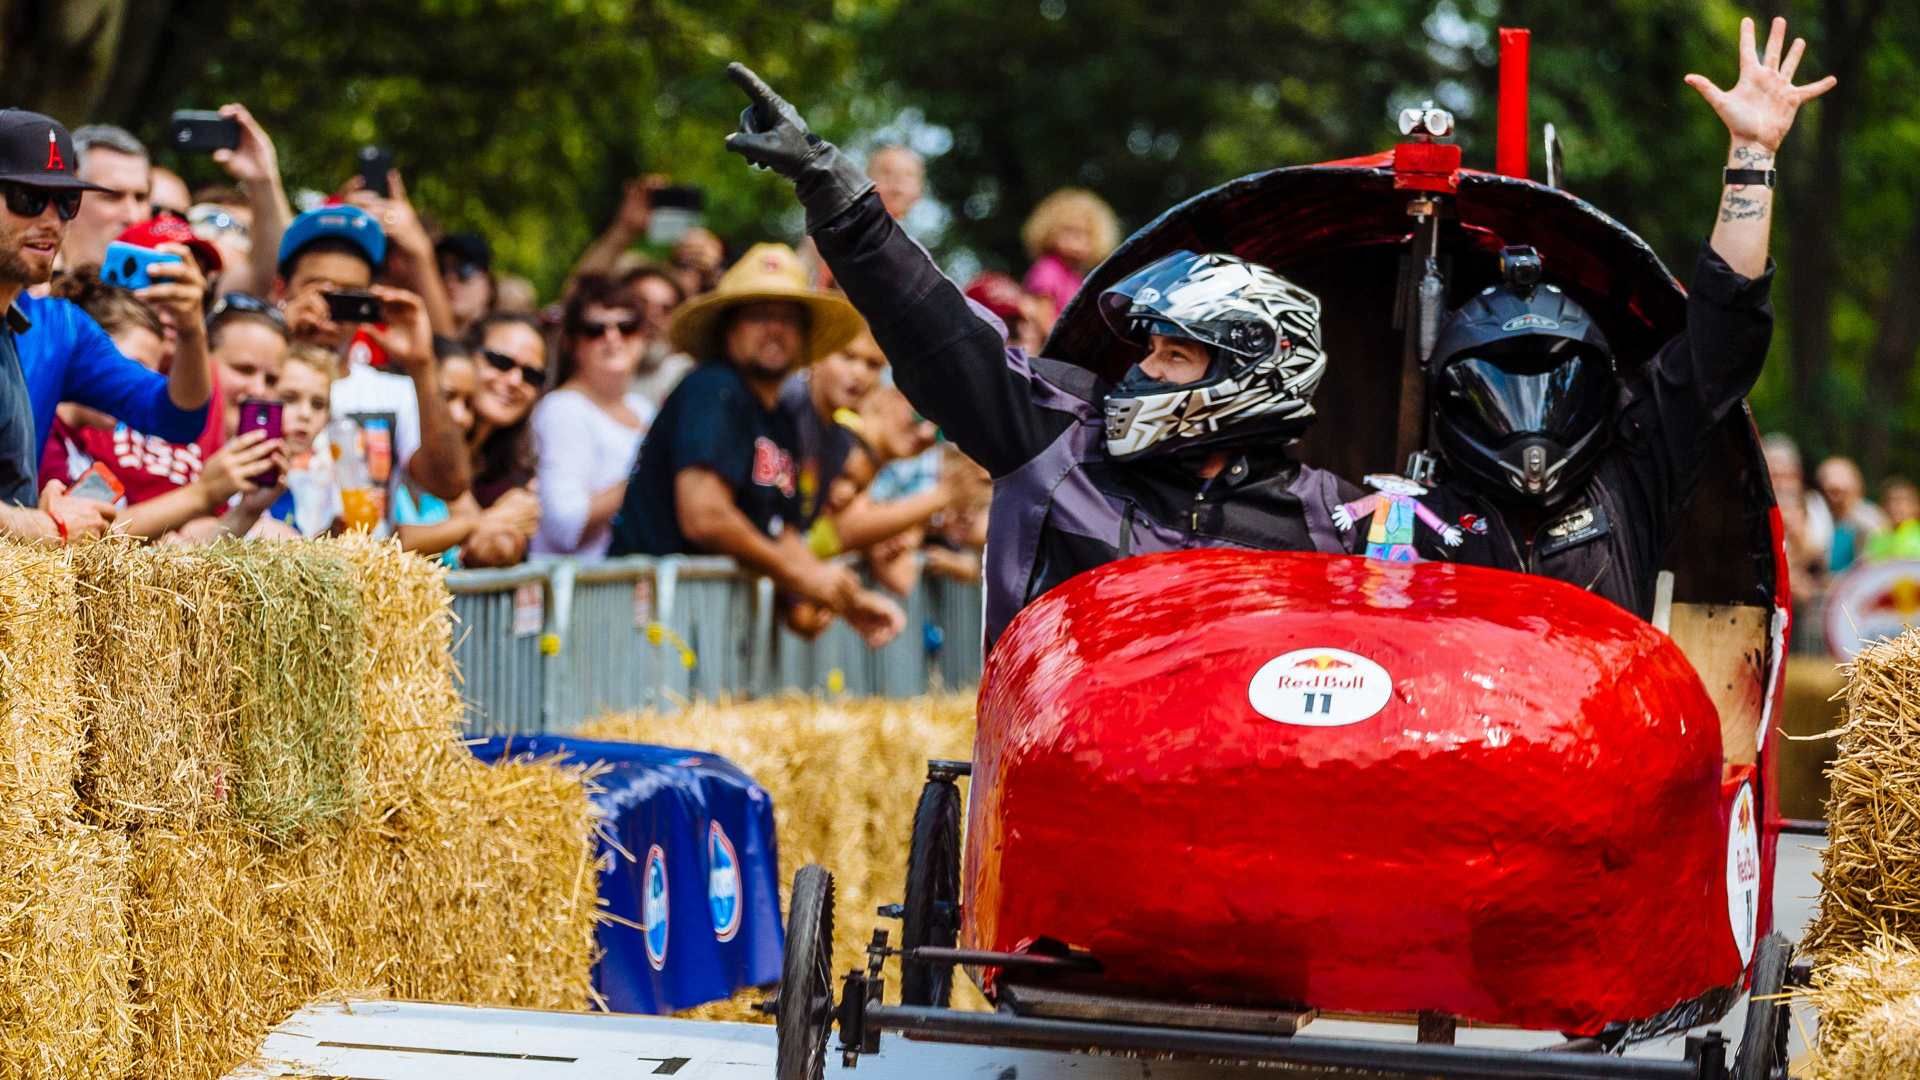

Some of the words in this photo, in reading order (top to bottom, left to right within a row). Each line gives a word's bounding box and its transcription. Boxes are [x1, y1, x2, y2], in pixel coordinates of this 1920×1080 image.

[1278, 675, 1320, 689] Red
[1324, 676, 1364, 689] Bull
[1303, 692, 1332, 714] 11
